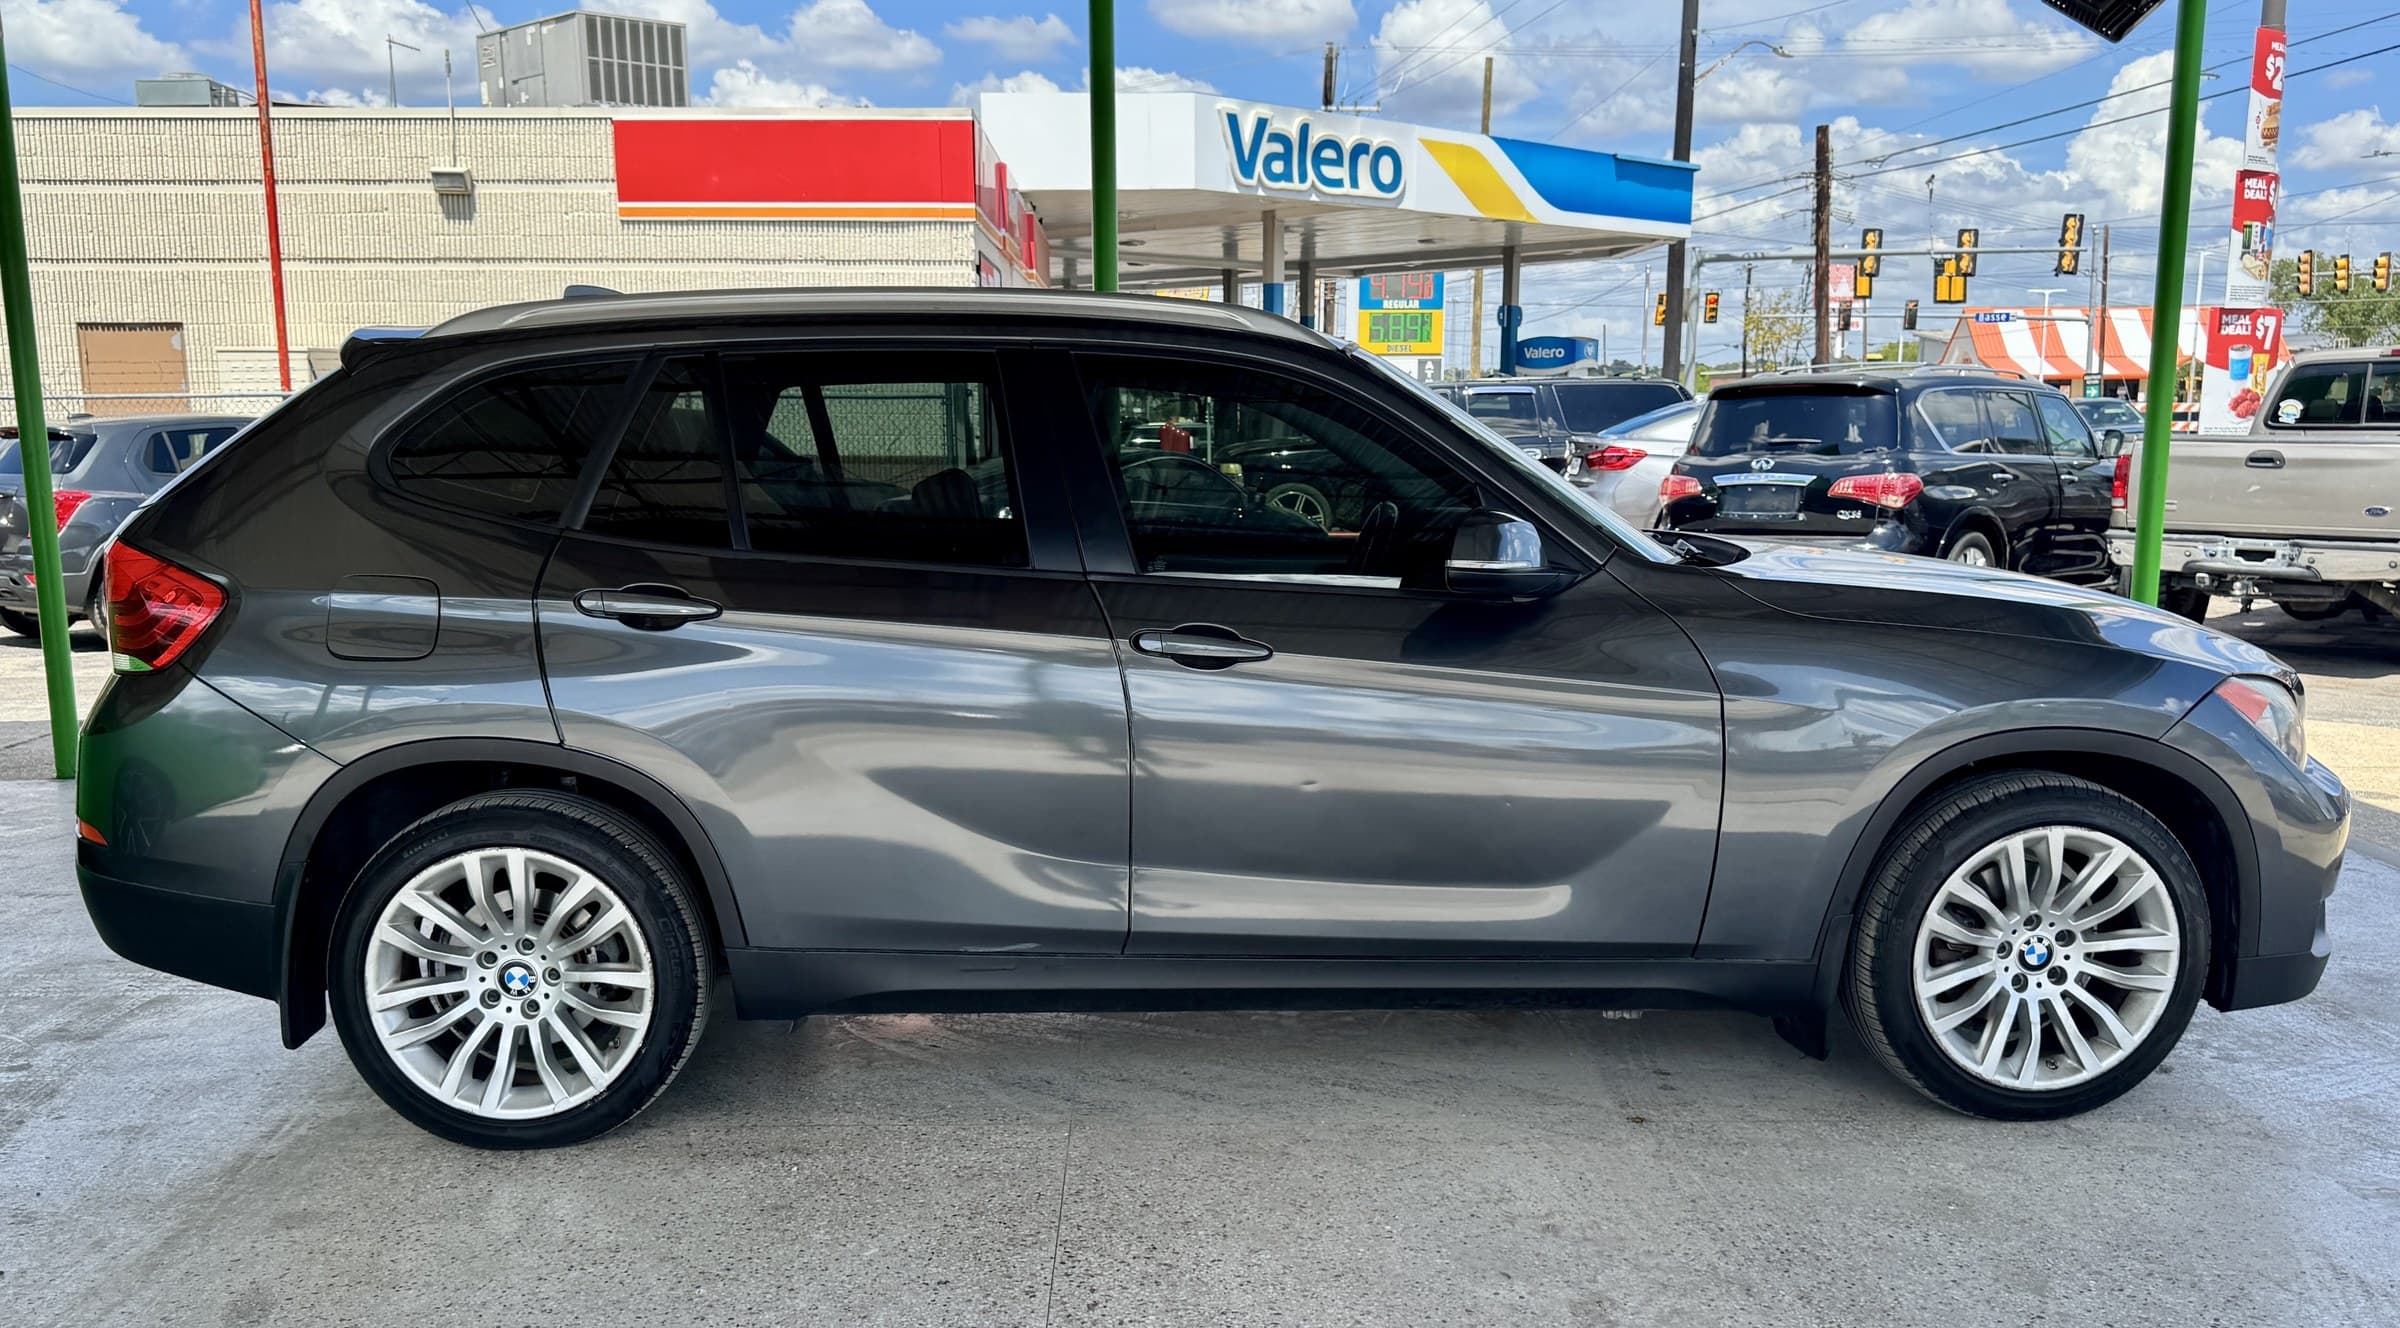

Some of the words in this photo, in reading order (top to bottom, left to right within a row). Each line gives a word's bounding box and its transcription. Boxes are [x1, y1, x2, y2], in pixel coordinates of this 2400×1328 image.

[1226, 112, 1403, 194] Valero
[2244, 178, 2267, 189] MEAL
[1383, 300, 1419, 309] REGULAR
[2221, 314, 2252, 325] MEAL
[2255, 314, 2277, 350] $7
[1387, 344, 1413, 352] DIESEL
[1524, 347, 1565, 359] Valero
